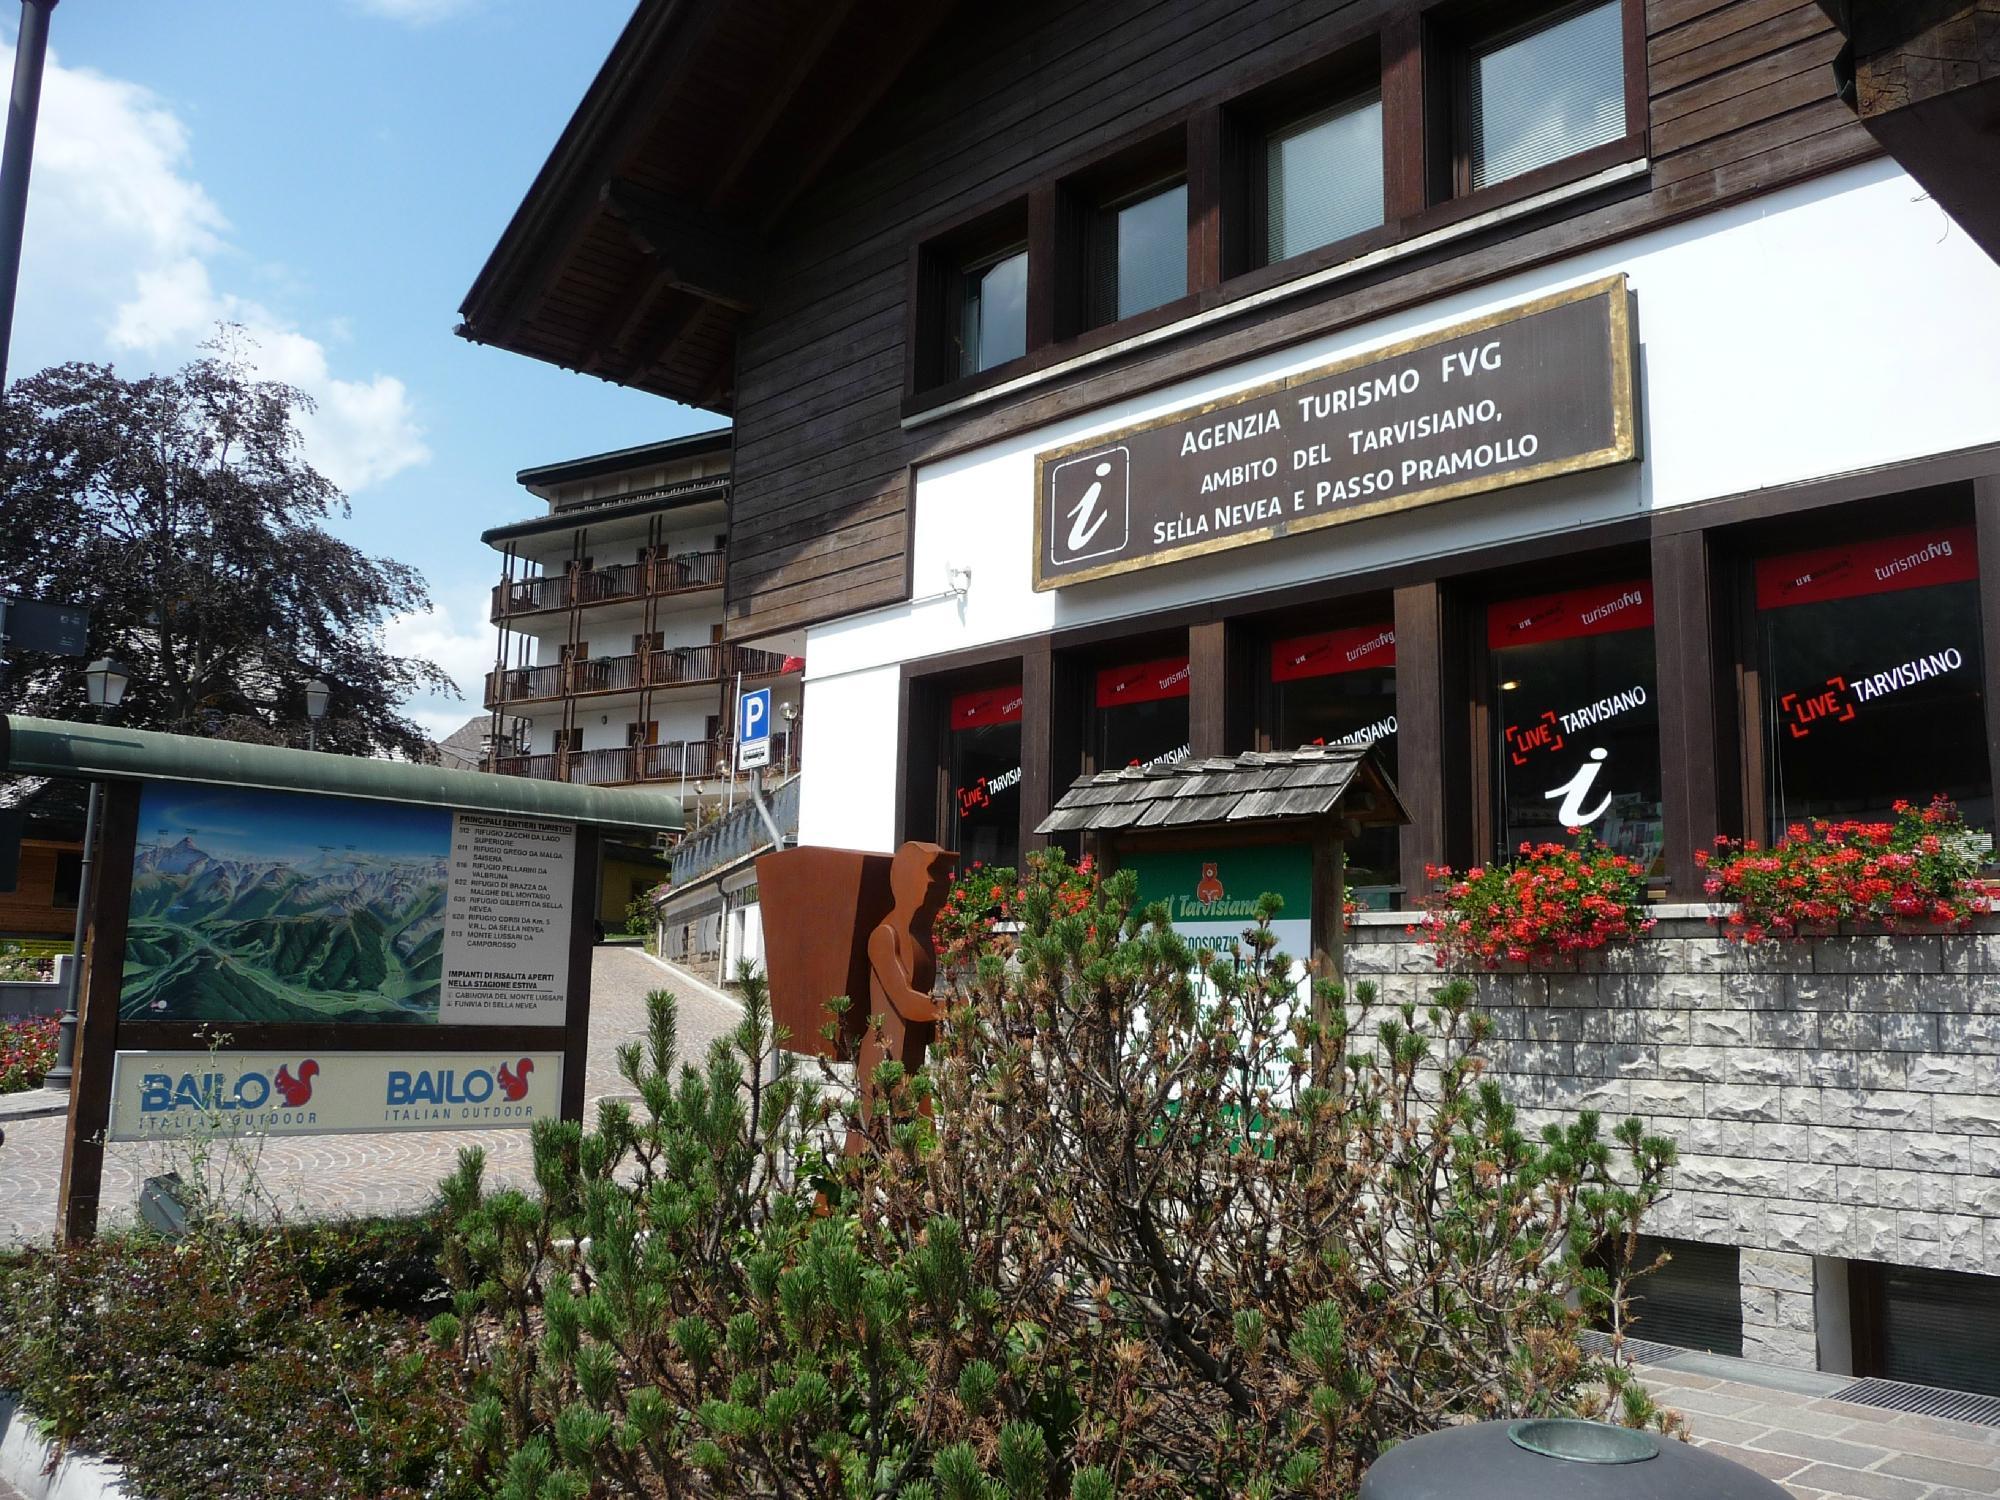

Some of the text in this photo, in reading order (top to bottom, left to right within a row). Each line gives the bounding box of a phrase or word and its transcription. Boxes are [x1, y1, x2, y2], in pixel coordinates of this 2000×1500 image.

[1181, 341, 1502, 457] AGENZIA TURISMO FVG
[1200, 399, 1503, 495] AMBITO DEL TARVISIANO,
[1153, 433, 1538, 545] SELLA NEVEA E PASSO PRAMOLLO
[1875, 539, 1953, 581] turismofvg
[1582, 590, 1643, 625] turismofvg
[1159, 664, 1190, 689] turismof
[1796, 647, 1962, 723] LIVE TARVISIANO
[1002, 697, 1023, 715] turism
[746, 696, 764, 737] P
[1517, 685, 1647, 754] LIVE TARVISIANO
[964, 766, 1021, 807] LIVE TARVISIA
[460, 815, 572, 832] PRINCIPALI SENTIERI TURISTICI
[474, 837, 514, 846] SUPERIORE
[475, 828, 503, 837] RIFUGIO
[504, 831, 530, 840] ZACCHI
[542, 835, 561, 843] LAGO
[473, 845, 502, 853] RIFUGIO
[539, 851, 563, 859] MALGA
[472, 862, 501, 871] RIFUGIO
[502, 865, 537, 874] PELLARINI
[472, 871, 509, 880] VALBRUNA
[470, 879, 500, 888] RIFUGIO
[500, 881, 508, 889] DI
[470, 888, 551, 900] MALGHE DEL MONTASIO
[468, 905, 492, 913] NEVEA
[469, 897, 499, 905] RIFUGIO
[499, 899, 531, 907] GILBERTI
[468, 914, 497, 922] RIFUGIO
[467, 931, 492, 939] MONTE
[494, 932, 522, 940] LUSSARI
[499, 924, 520, 932] SELLA
[467, 940, 517, 949] CAMPOROSSO
[448, 970, 554, 981] IMPIANTI DI RISALITA APERTI
[474, 980, 511, 988] STAGIONE
[512, 981, 537, 989] ESTIVA
[454, 1000, 482, 1008] FUNIVIA
[141, 1072, 270, 1112] BAILO
[386, 1069, 494, 1105] BAILO
[139, 1112, 316, 1129] ITALIA OUTDOOR
[384, 1105, 533, 1121] ITALIAN OUTDOOR
